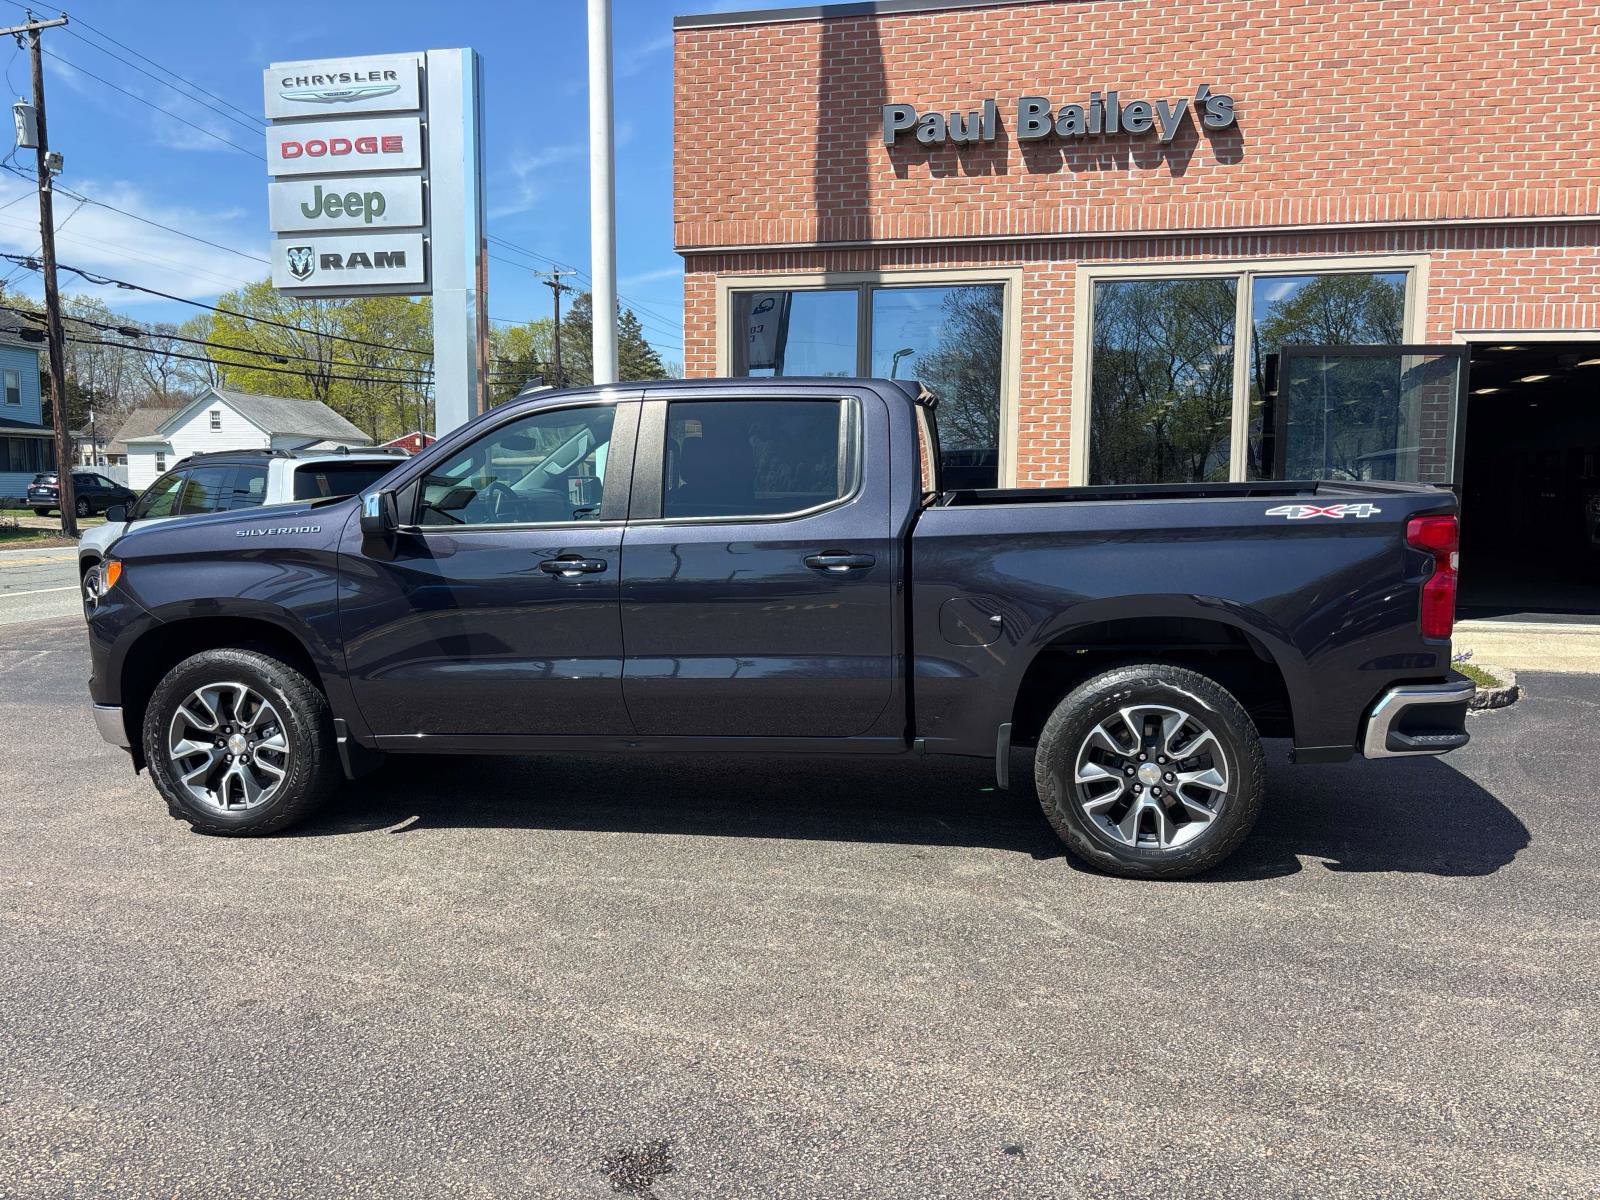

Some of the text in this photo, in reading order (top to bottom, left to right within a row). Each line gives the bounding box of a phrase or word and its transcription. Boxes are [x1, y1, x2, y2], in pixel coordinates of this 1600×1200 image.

[281, 70, 398, 88] CHRYSLER
[883, 84, 1235, 146] Paul Bailey's
[281, 136, 404, 159] DODGE
[301, 185, 386, 223] Jeep
[320, 251, 406, 270] RAM
[236, 525, 322, 537] SILVERADO
